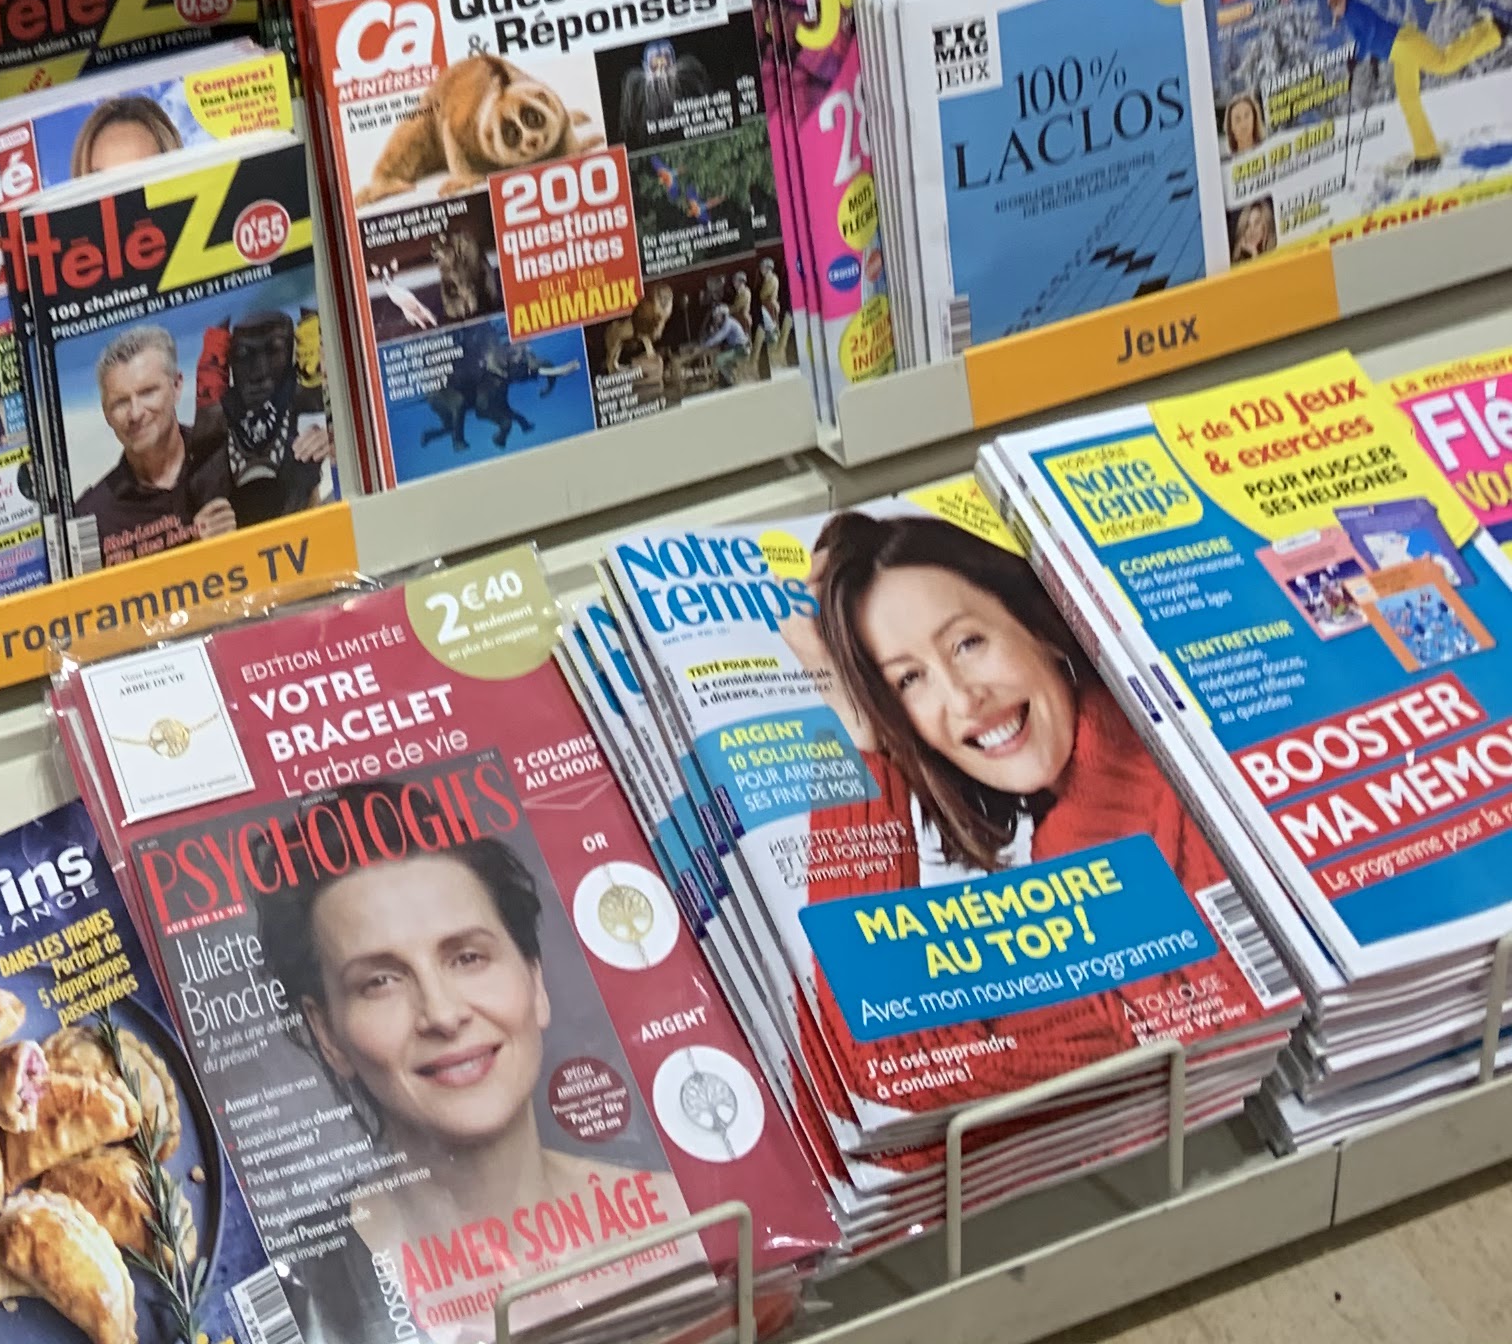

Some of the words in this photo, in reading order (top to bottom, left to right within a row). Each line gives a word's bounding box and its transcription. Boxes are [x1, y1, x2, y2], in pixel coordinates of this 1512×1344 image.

[935, 62, 991, 95] JEUX
[1015, 49, 1129, 123] 100%
[951, 77, 1185, 193] LACLOS
[501, 153, 620, 230] 200
[502, 206, 629, 266] questions
[513, 235, 625, 283] insolites
[48, 301, 81, 322] 100
[51, 298, 145, 340] PROGRAMMES
[222, 263, 273, 291] FÉVRIER
[511, 277, 639, 335] ANIMAUX
[1116, 314, 1201, 363] Jeux
[1235, 417, 1377, 471] exercices
[1066, 456, 1154, 501] Notre
[1296, 463, 1409, 513] NEURONES
[257, 537, 310, 584] TV
[617, 531, 771, 586] Notre
[637, 574, 823, 634] temps
[248, 662, 383, 720] VOTRE
[265, 683, 455, 764] BRACELET
[1241, 680, 1481, 801] BOOSTER
[277, 750, 366, 799] L'arbre
[747, 738, 846, 768] SOLUTIONS
[145, 761, 523, 923] PSYCHOLOGIES
[854, 904, 924, 945] MA
[934, 857, 1126, 933] MÉMOIRE
[175, 933, 268, 989] Juliette
[859, 993, 917, 1030] Avec
[919, 984, 969, 1016] mon
[972, 968, 1065, 1008] nouveau
[1069, 929, 1200, 986] programme
[182, 976, 291, 1039] Binoche
[400, 1208, 511, 1294] AIMER
[515, 1194, 592, 1262] SON
[594, 1168, 670, 1246] ÂGE
